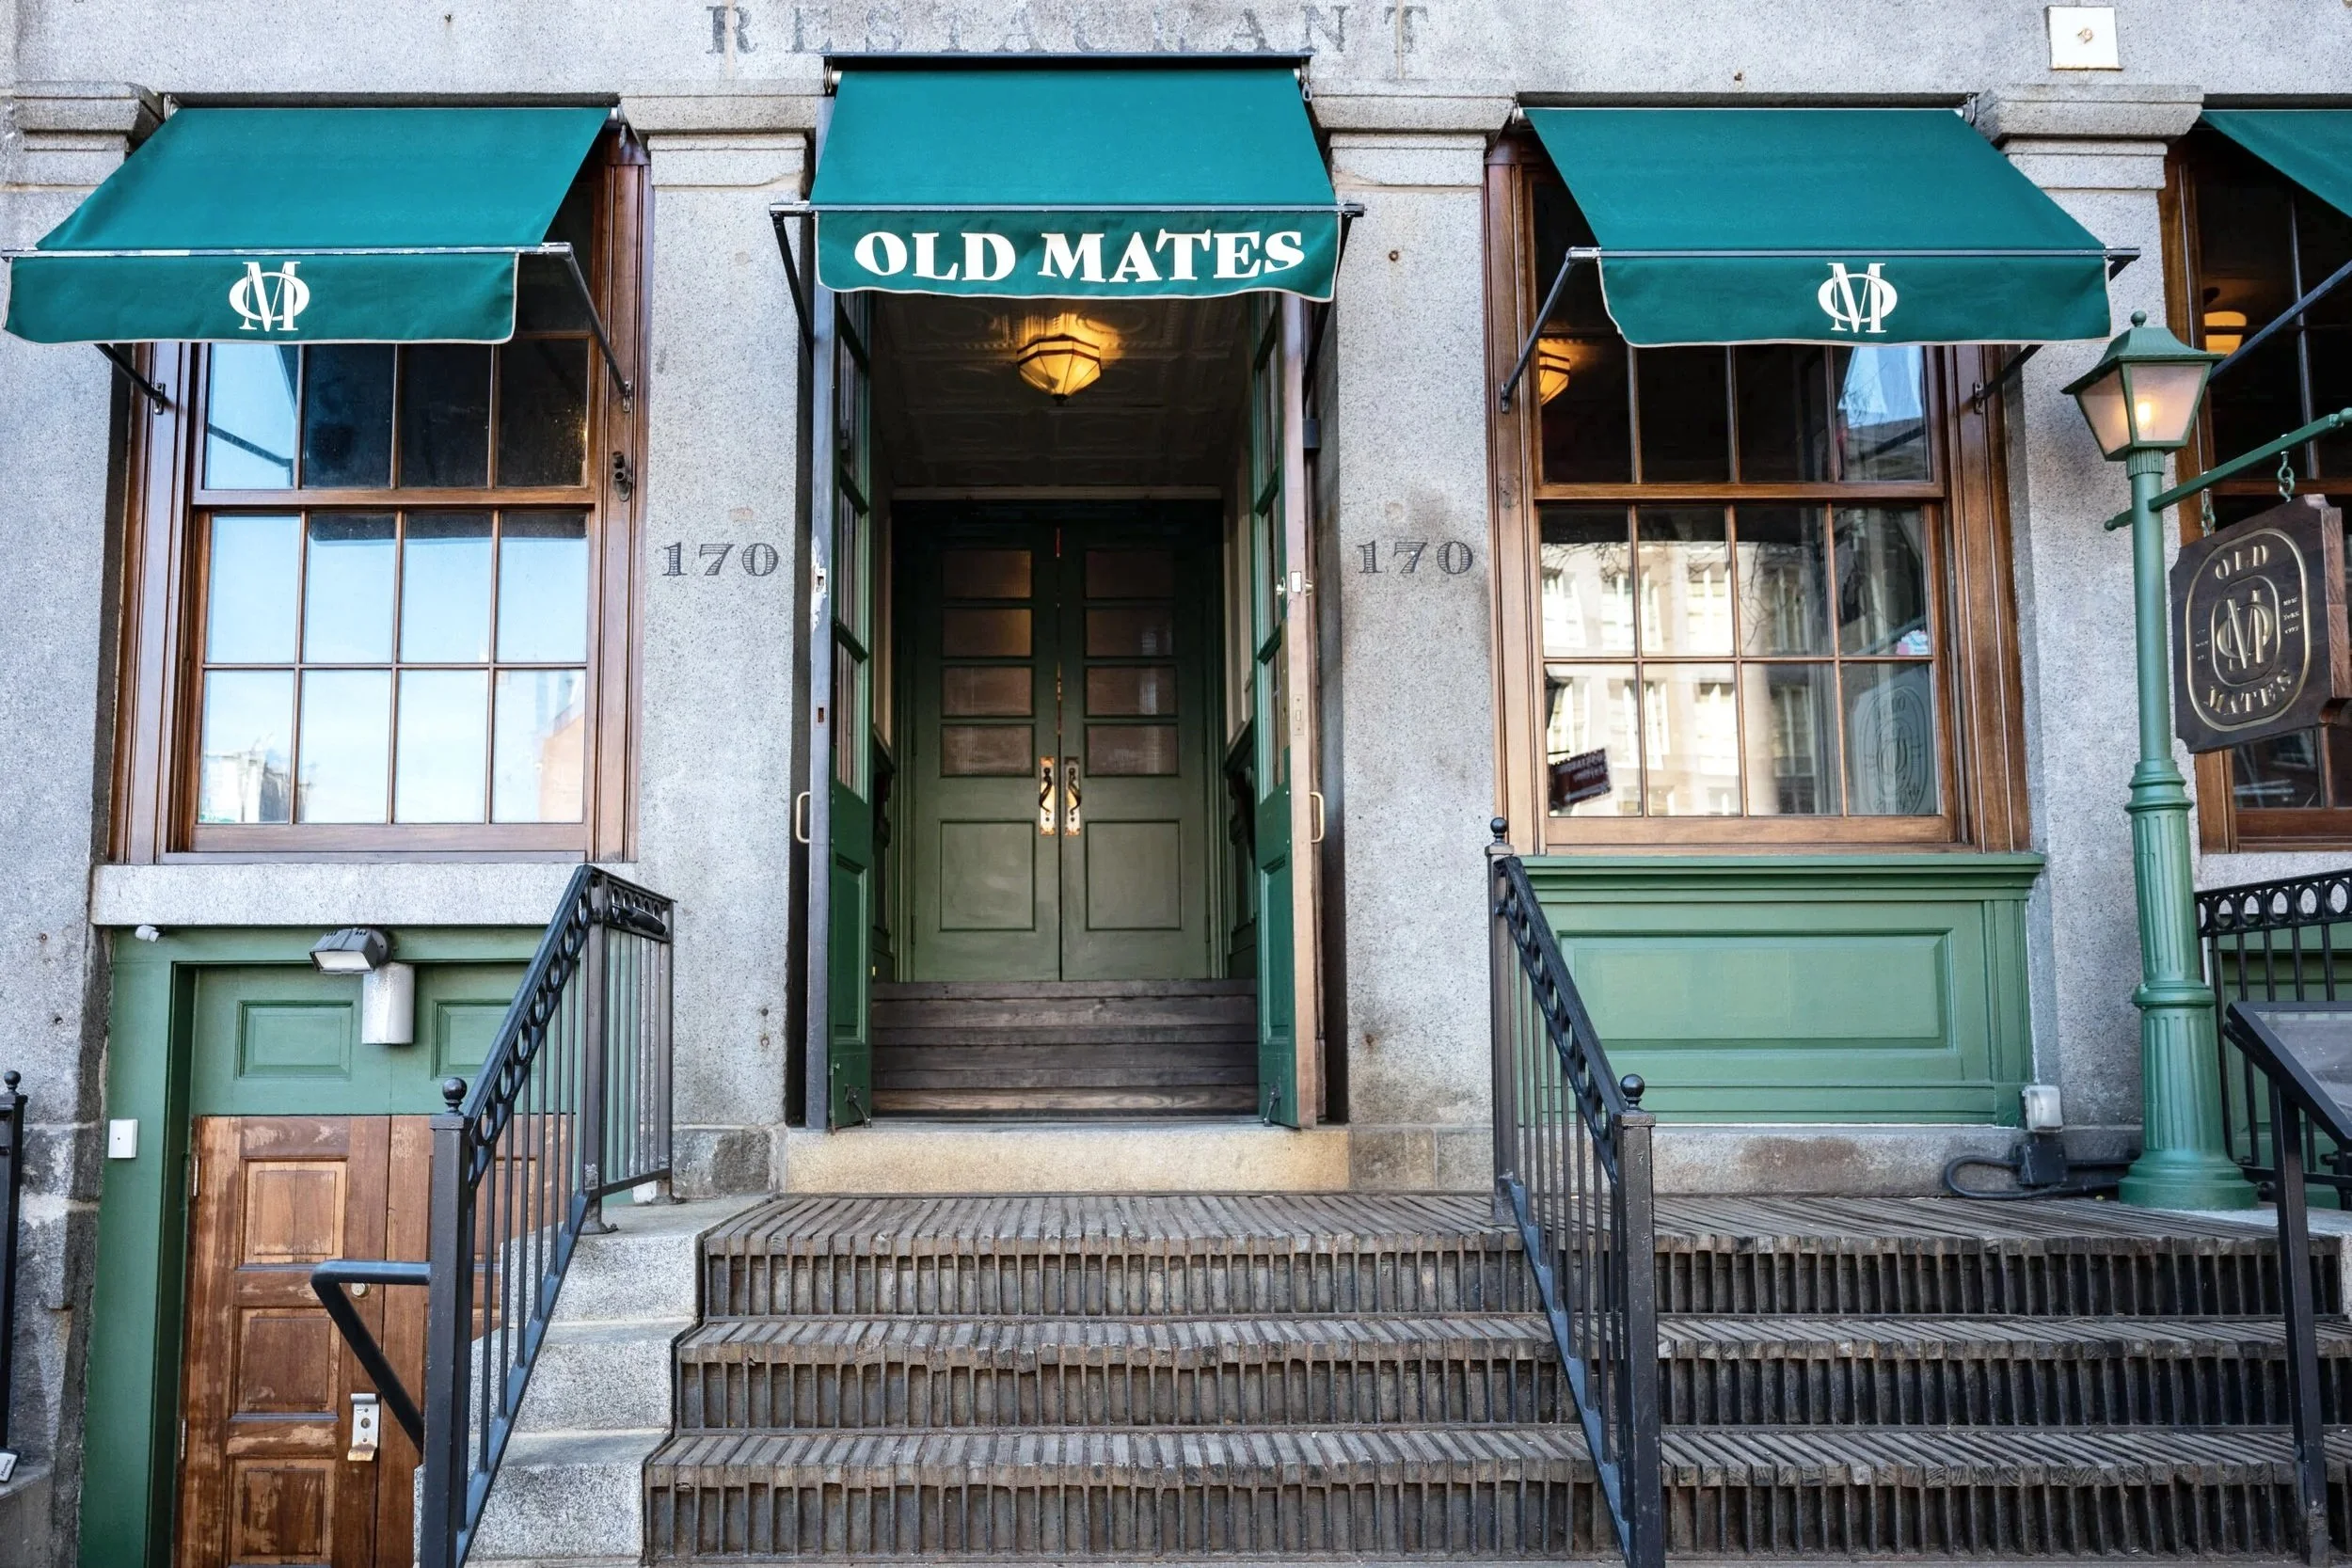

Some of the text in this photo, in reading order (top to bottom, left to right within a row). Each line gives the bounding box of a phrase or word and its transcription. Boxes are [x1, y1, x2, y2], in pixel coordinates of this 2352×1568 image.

[853, 228, 1306, 283] OLD MATES
[661, 541, 779, 577] 170
[1357, 540, 1474, 575] 170
[2215, 544, 2270, 580] OLD
[2201, 668, 2292, 716] MATES
